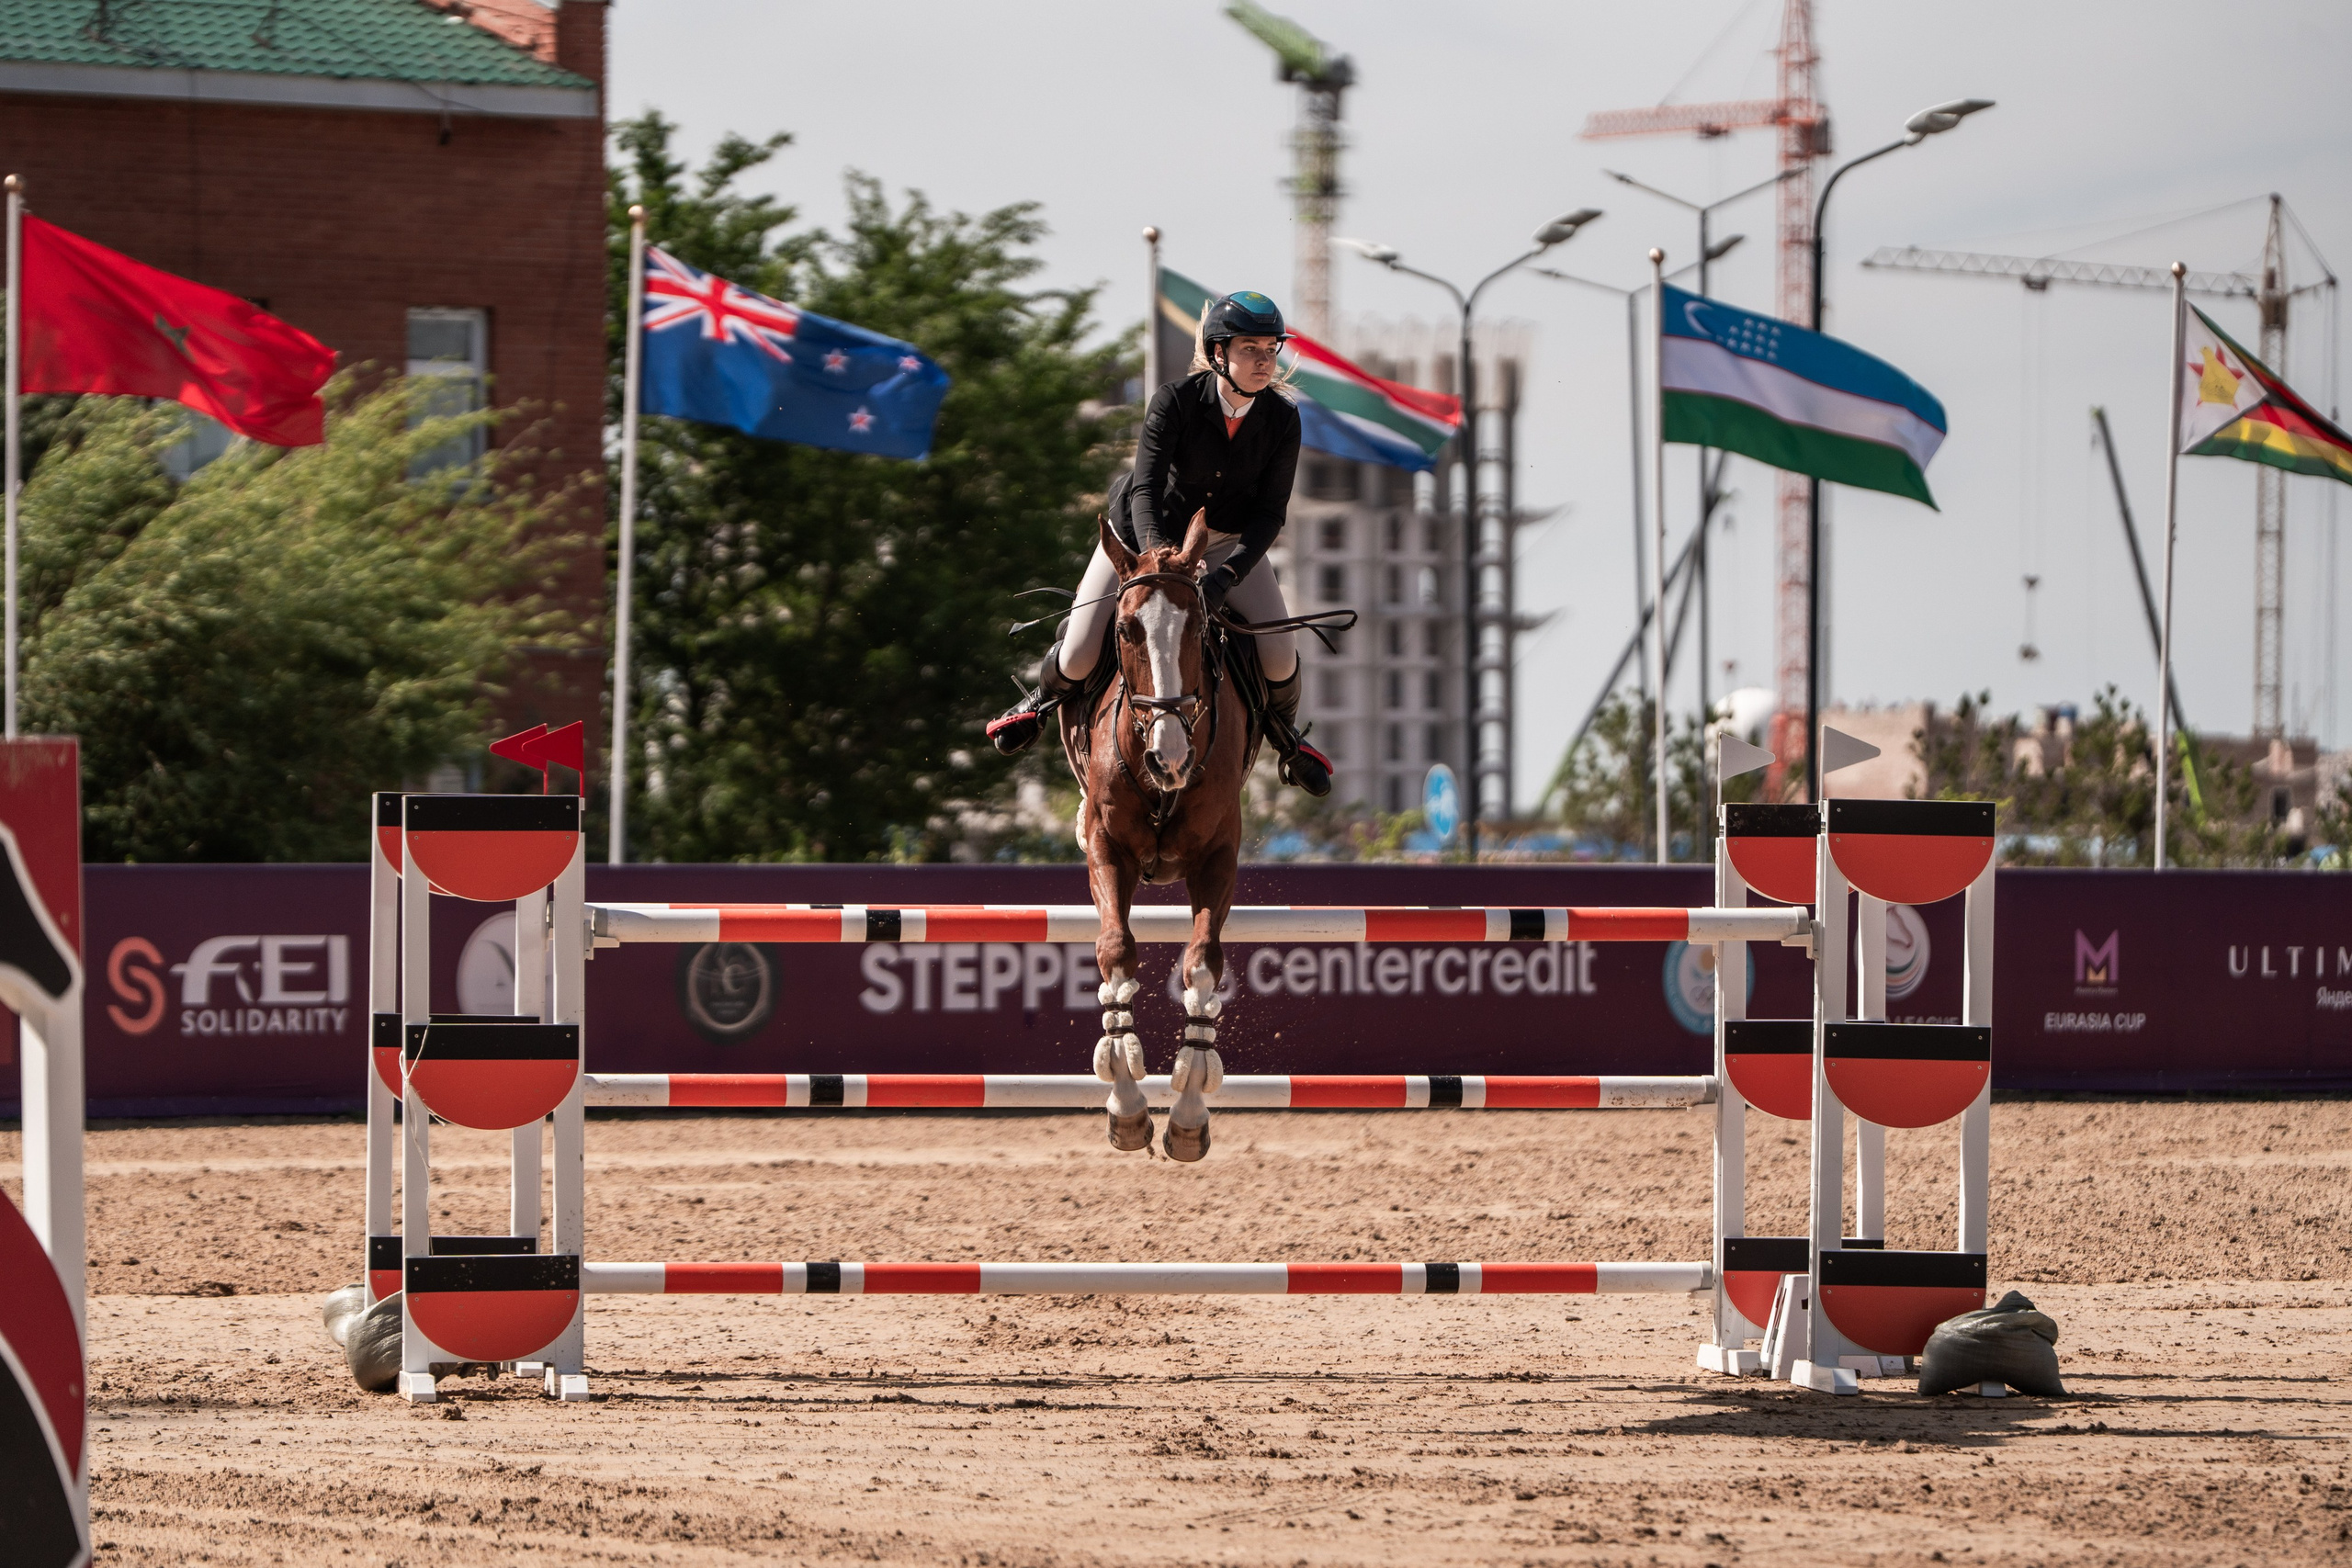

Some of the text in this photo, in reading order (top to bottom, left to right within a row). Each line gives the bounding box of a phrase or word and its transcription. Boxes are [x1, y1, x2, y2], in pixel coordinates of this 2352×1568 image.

[169, 934, 349, 1005] FEI
[859, 942, 1100, 1013] STEPPE
[1247, 942, 1598, 995] centercredit
[180, 1009, 350, 1035] SOLIDARITY
[2044, 1012, 2147, 1032] EURASIA CUP
